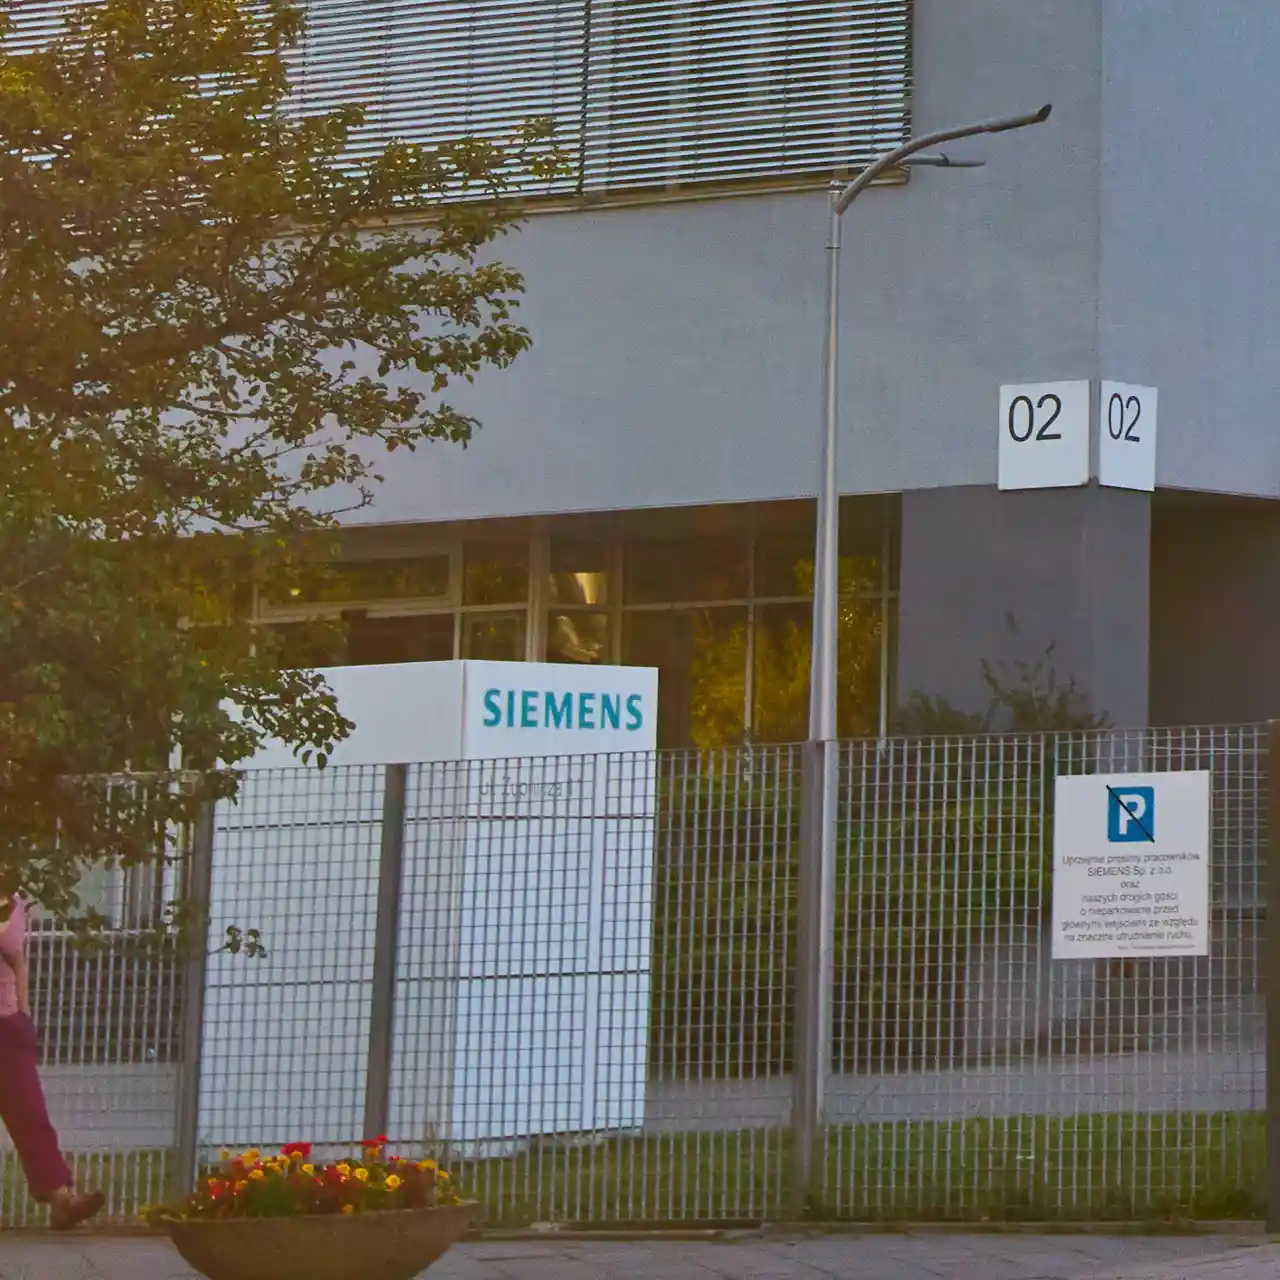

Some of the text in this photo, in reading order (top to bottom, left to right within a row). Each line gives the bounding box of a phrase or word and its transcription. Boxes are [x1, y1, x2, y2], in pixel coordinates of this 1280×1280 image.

[1008, 393, 1062, 442] 02
[1108, 393, 1141, 442] 02
[483, 688, 643, 730] SIEMENS
